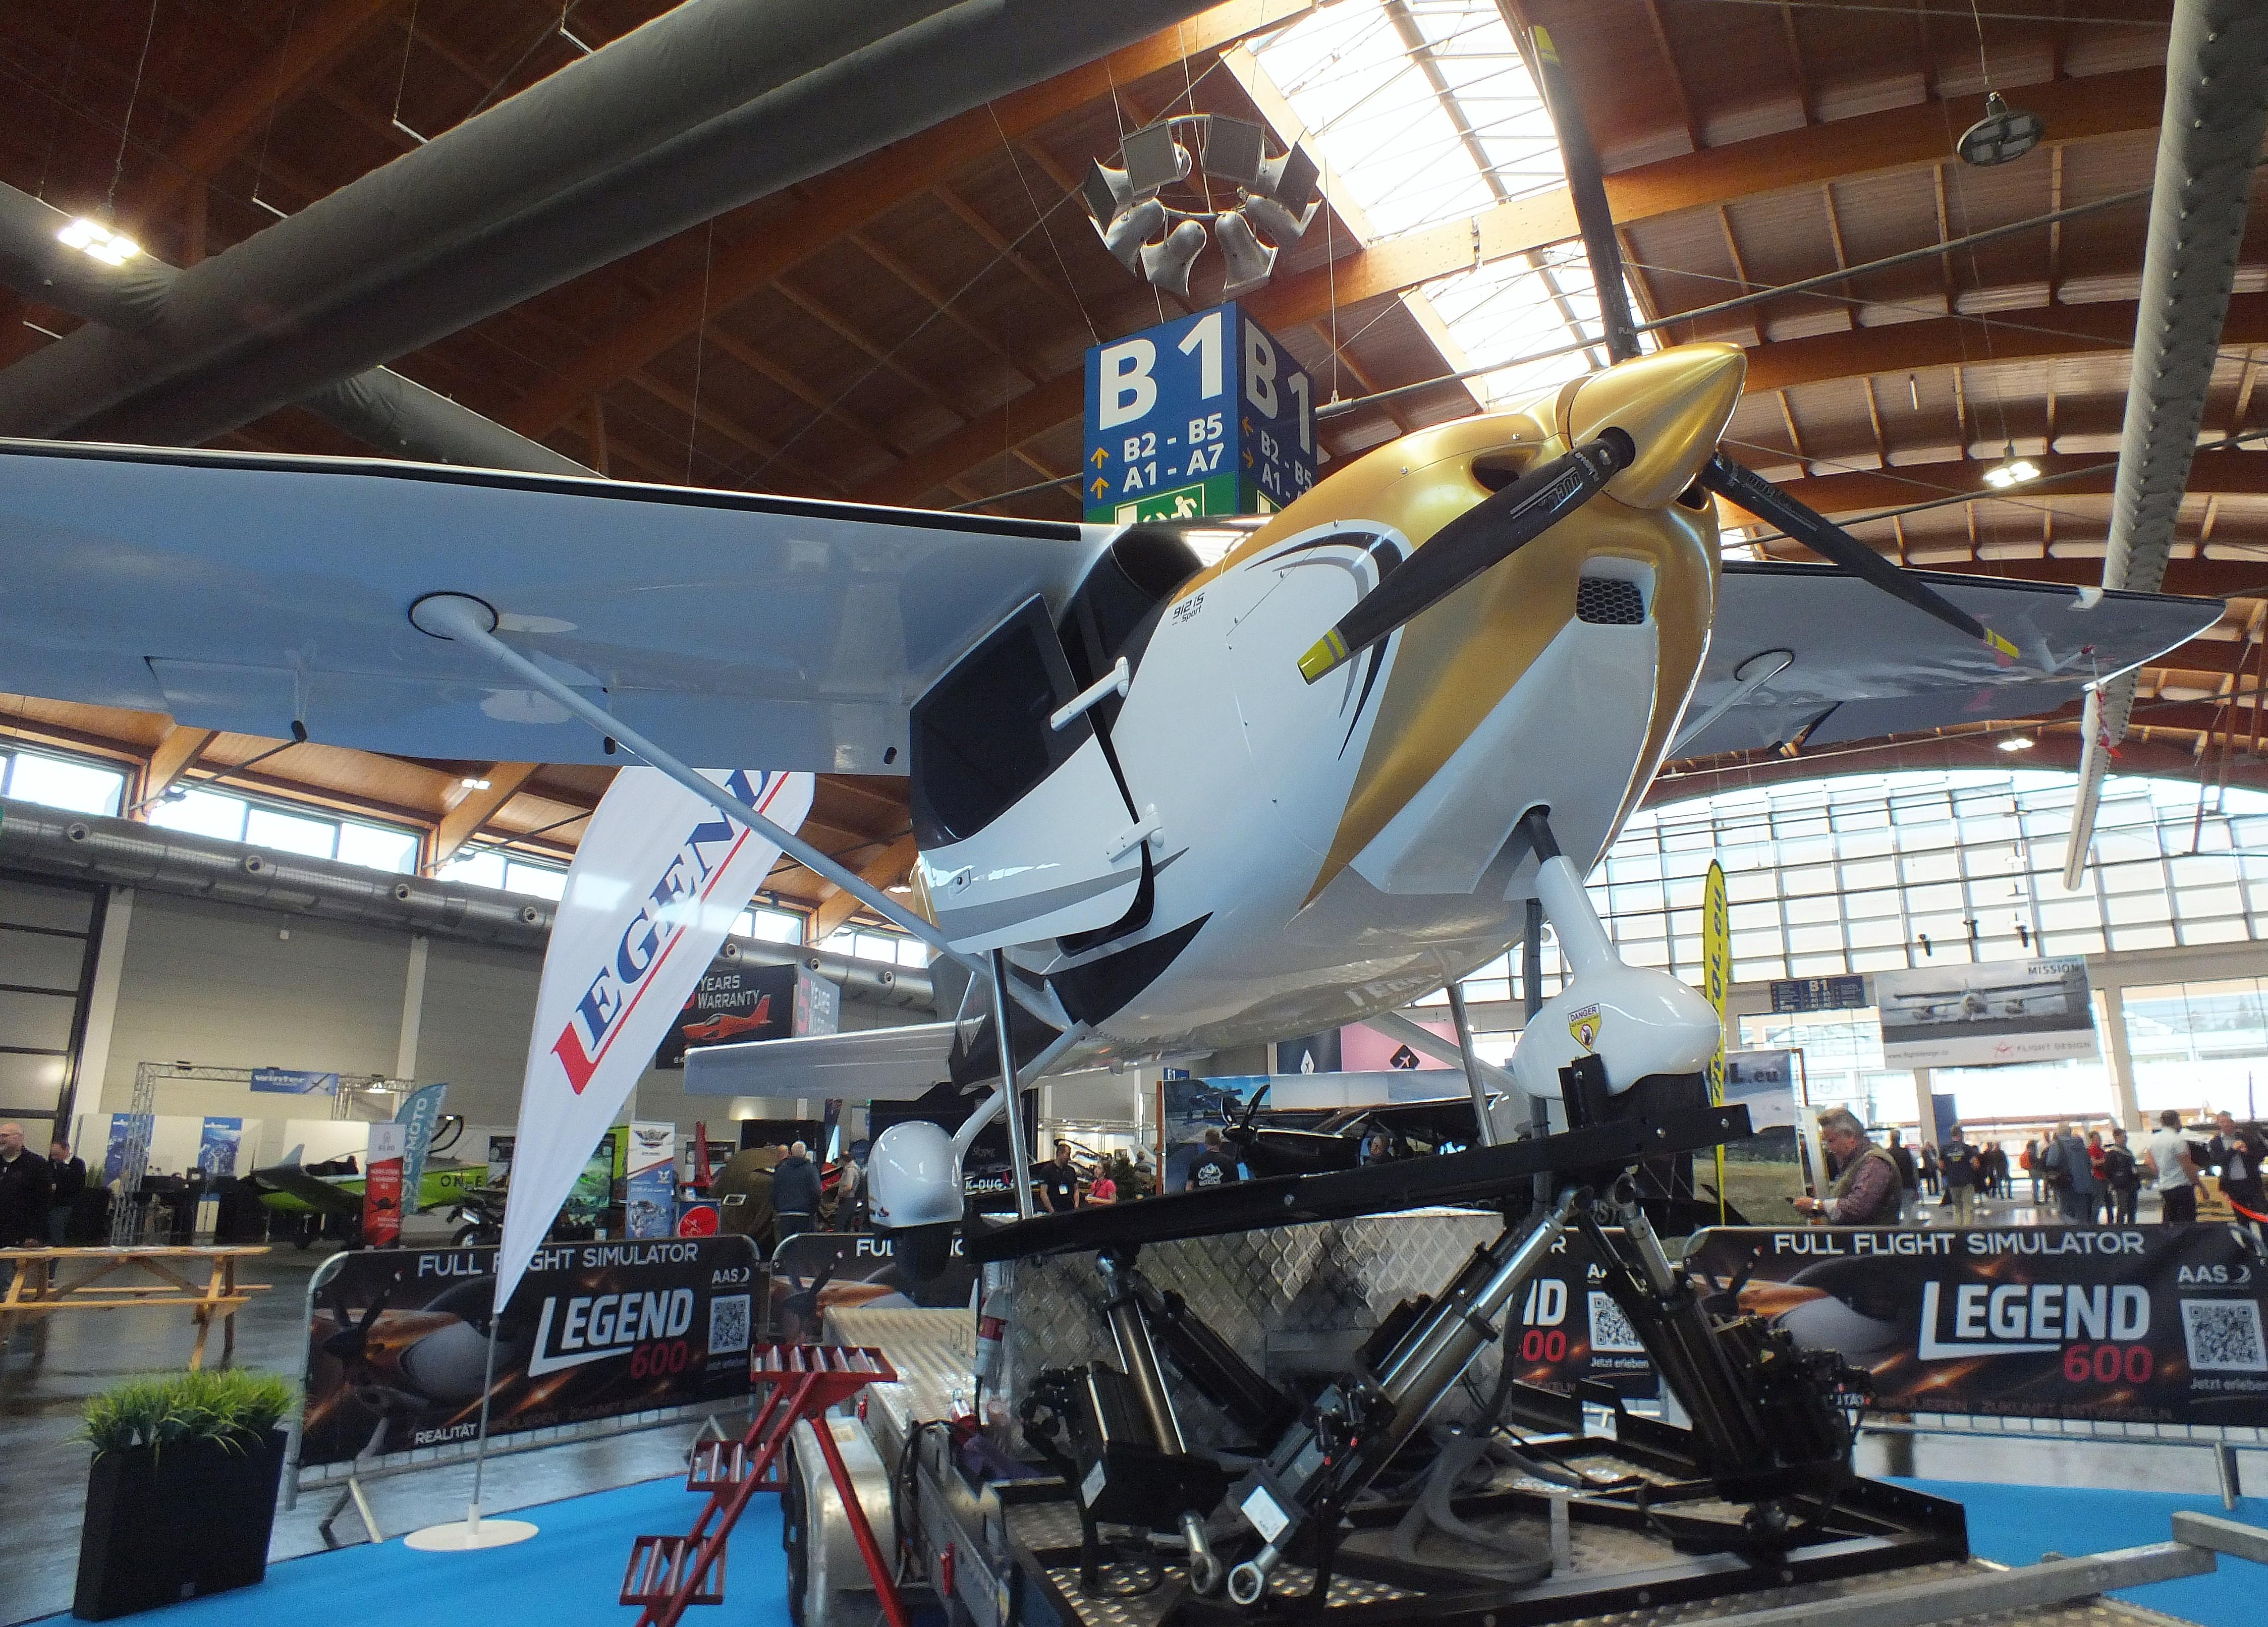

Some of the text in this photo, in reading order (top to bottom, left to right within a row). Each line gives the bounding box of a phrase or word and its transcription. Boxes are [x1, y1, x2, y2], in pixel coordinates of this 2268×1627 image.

[1124, 413, 1224, 463] B2 - B5
[1123, 443, 1225, 493] A1 - A7
[1261, 429, 1279, 465] B2
[1295, 460, 1312, 490] B5
[1261, 463, 1280, 495] A1
[1181, 605, 1203, 623] Sport
[697, 989, 760, 1009] WARRANTY
[699, 974, 741, 992] YEARS
[1570, 1006, 1596, 1021] DANGER
[1773, 1231, 2145, 1256] FULL FLIGHT SIMULATOR
[417, 1243, 699, 1277] FULL FGHT SIMULATOR
[2177, 1264, 2229, 1283] AAS
[711, 1269, 739, 1284] AAS
[528, 1287, 694, 1378] LEGEND
[1918, 1281, 2151, 1361] LEGEND
[630, 1341, 689, 1380] 600
[1522, 1329, 1567, 1362] 00
[2064, 1344, 2153, 1383] 600
[414, 1422, 478, 1445] REALITÄT
